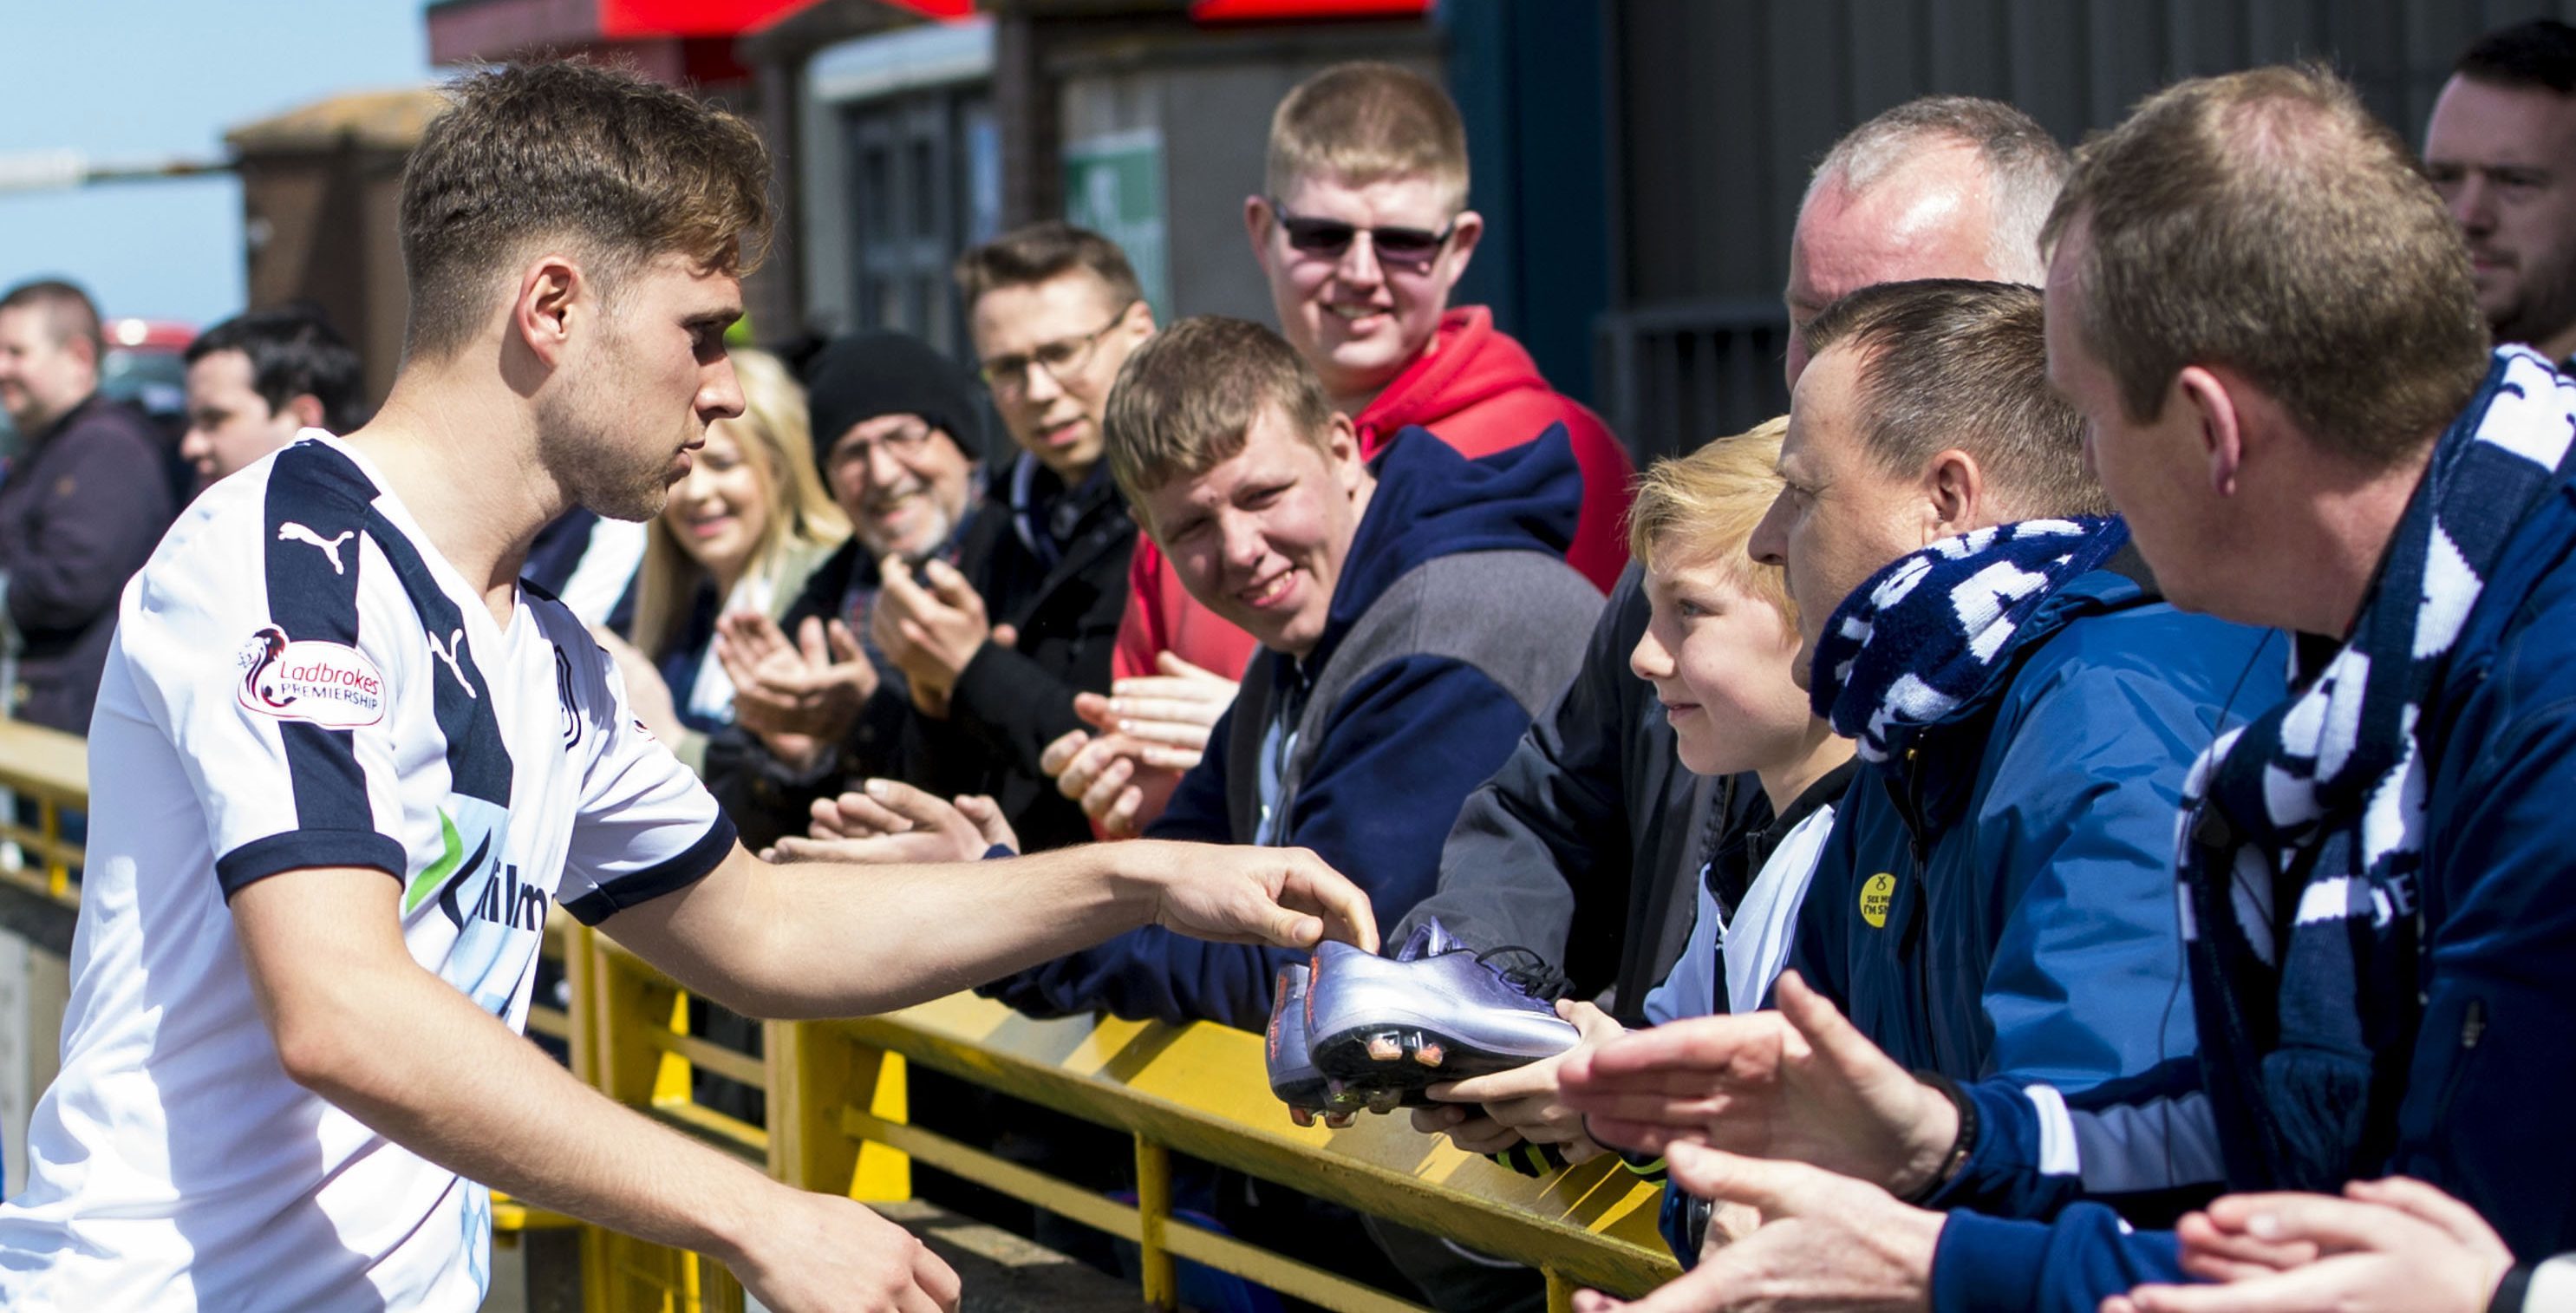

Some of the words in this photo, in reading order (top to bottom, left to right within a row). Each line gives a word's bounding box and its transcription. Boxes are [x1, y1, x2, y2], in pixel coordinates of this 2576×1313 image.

[280, 660, 379, 696] Ladbrokes
[280, 683, 379, 711] PREMIERSHIP
[1867, 895, 1879, 904] SEE
[1881, 895, 1889, 904] M
[1863, 905, 1876, 915] I'M
